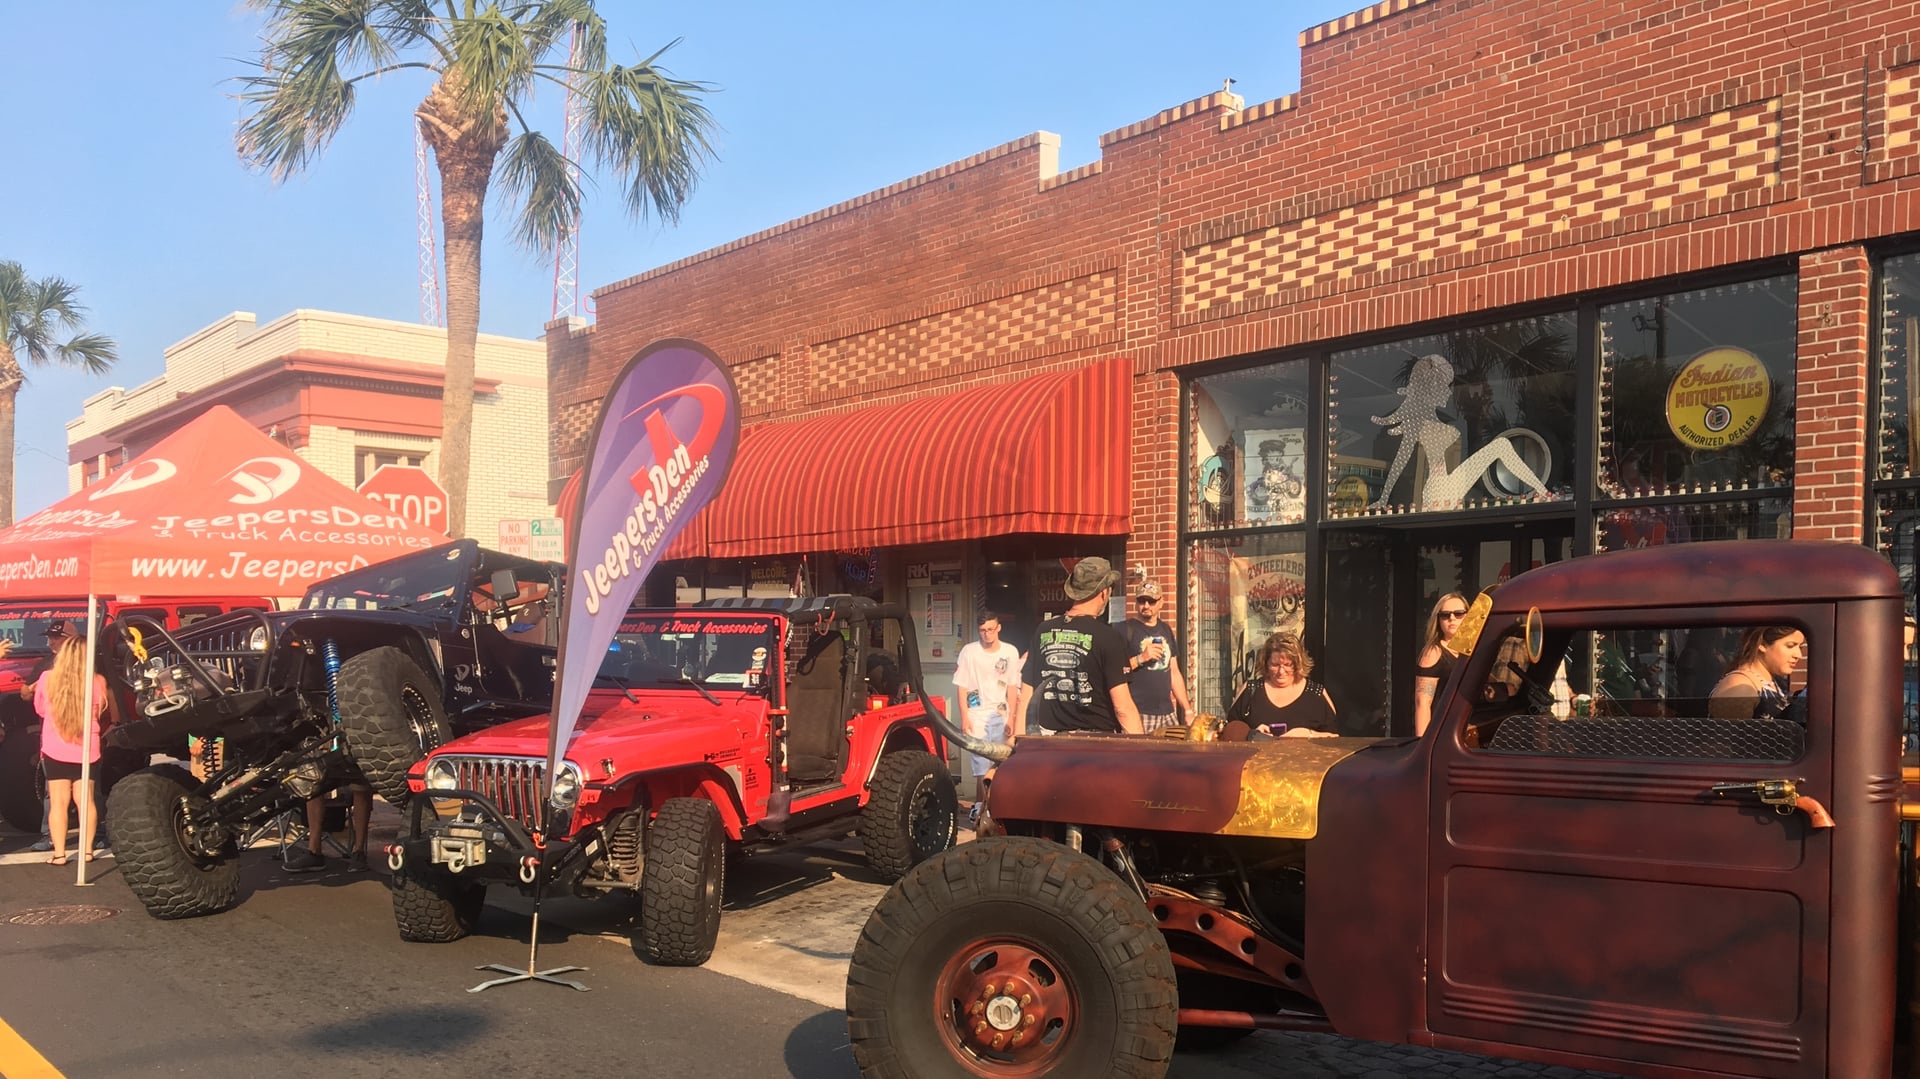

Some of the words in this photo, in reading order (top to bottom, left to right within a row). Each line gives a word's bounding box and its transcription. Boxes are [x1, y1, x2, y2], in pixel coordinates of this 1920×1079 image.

[1680, 363, 1757, 388] Indian
[1675, 381, 1763, 408] MOTORCYCLES
[1679, 424, 1724, 447] AUTHORIZED
[1728, 415, 1757, 442] DEALER
[151, 505, 408, 531] JeepersDen
[633, 551, 642, 569] &
[641, 517, 665, 555] Truck
[663, 454, 710, 523] Accessories
[184, 527, 268, 541] Truck
[279, 527, 433, 548] Accessories
[508, 523, 520, 533] NO
[532, 521, 540, 534] 2
[582, 443, 691, 614] JeepersDen
[500, 536, 528, 545] PARKING
[751, 567, 787, 579] WELCOME
[1248, 559, 1304, 580] 2WHEELERS
[672, 620, 701, 633] Truck
[702, 621, 768, 634] Accessories
[455, 683, 473, 694] Jeep
